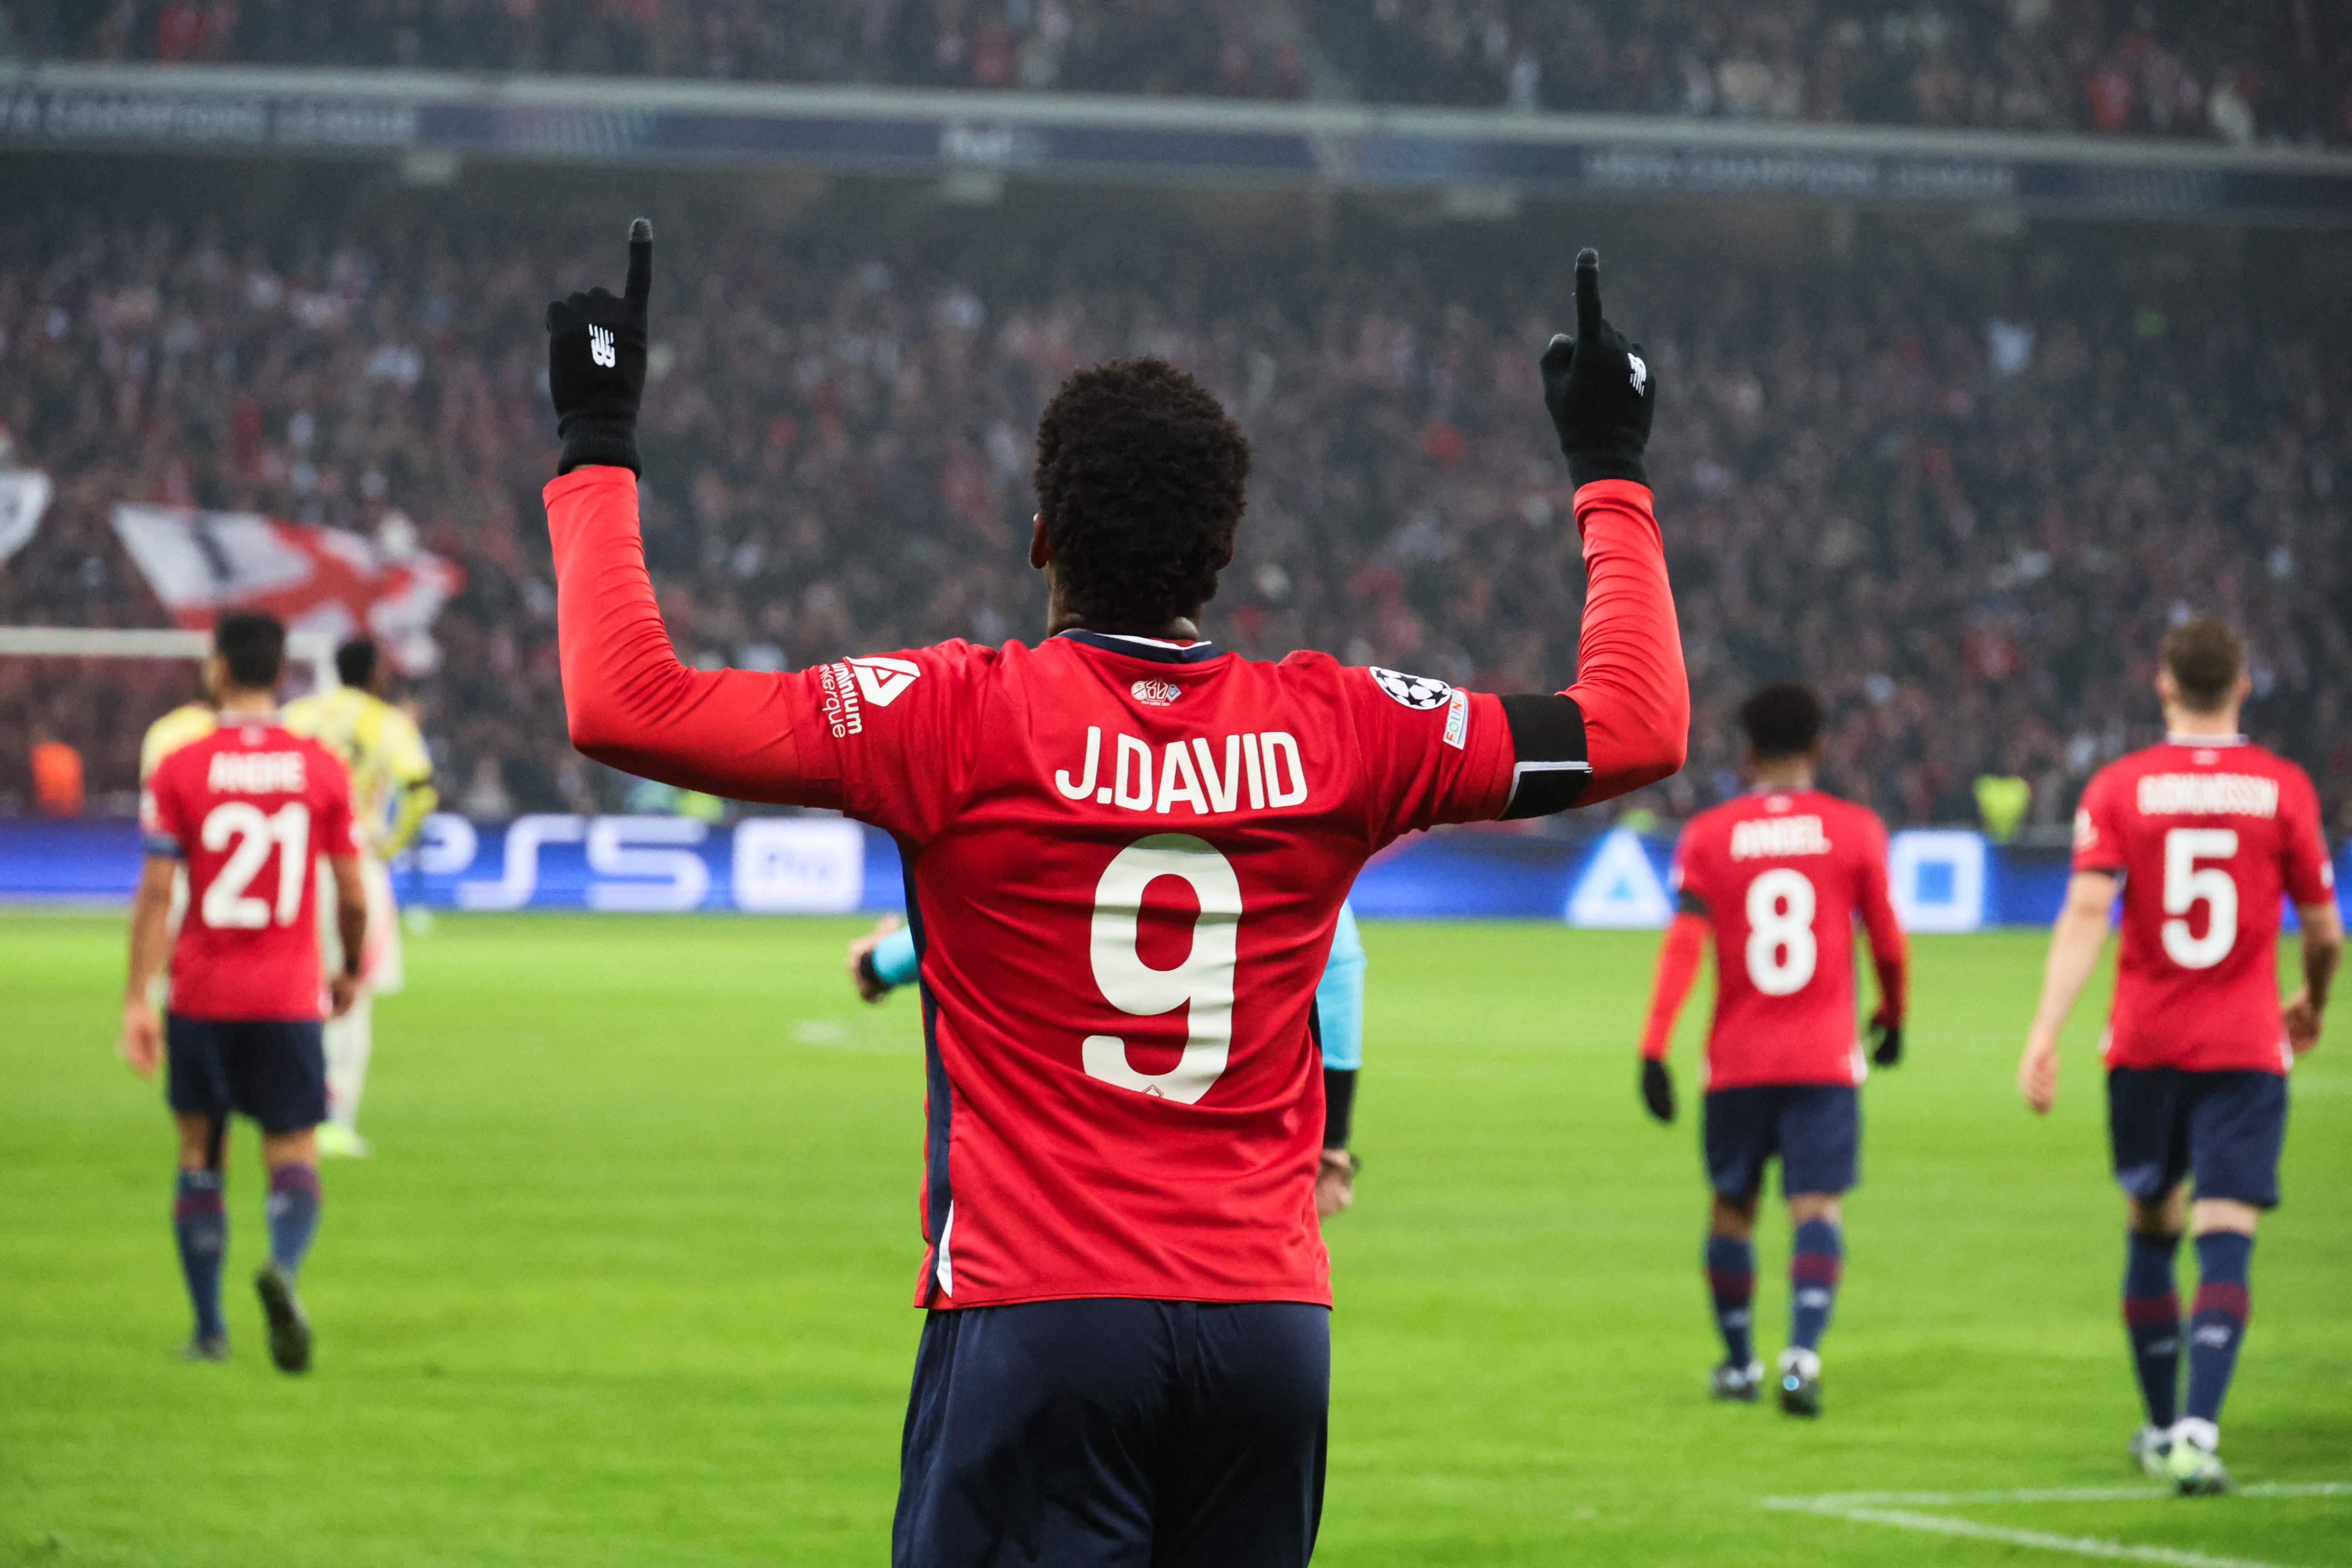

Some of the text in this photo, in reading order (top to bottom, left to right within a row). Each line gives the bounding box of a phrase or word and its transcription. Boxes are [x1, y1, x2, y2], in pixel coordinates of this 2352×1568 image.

[1055, 726, 1308, 814] J.DAVID
[201, 801, 310, 929] 21
[2161, 827, 2239, 969] 5
[1081, 833, 1243, 1105] 9
[1746, 867, 1817, 996] 8
